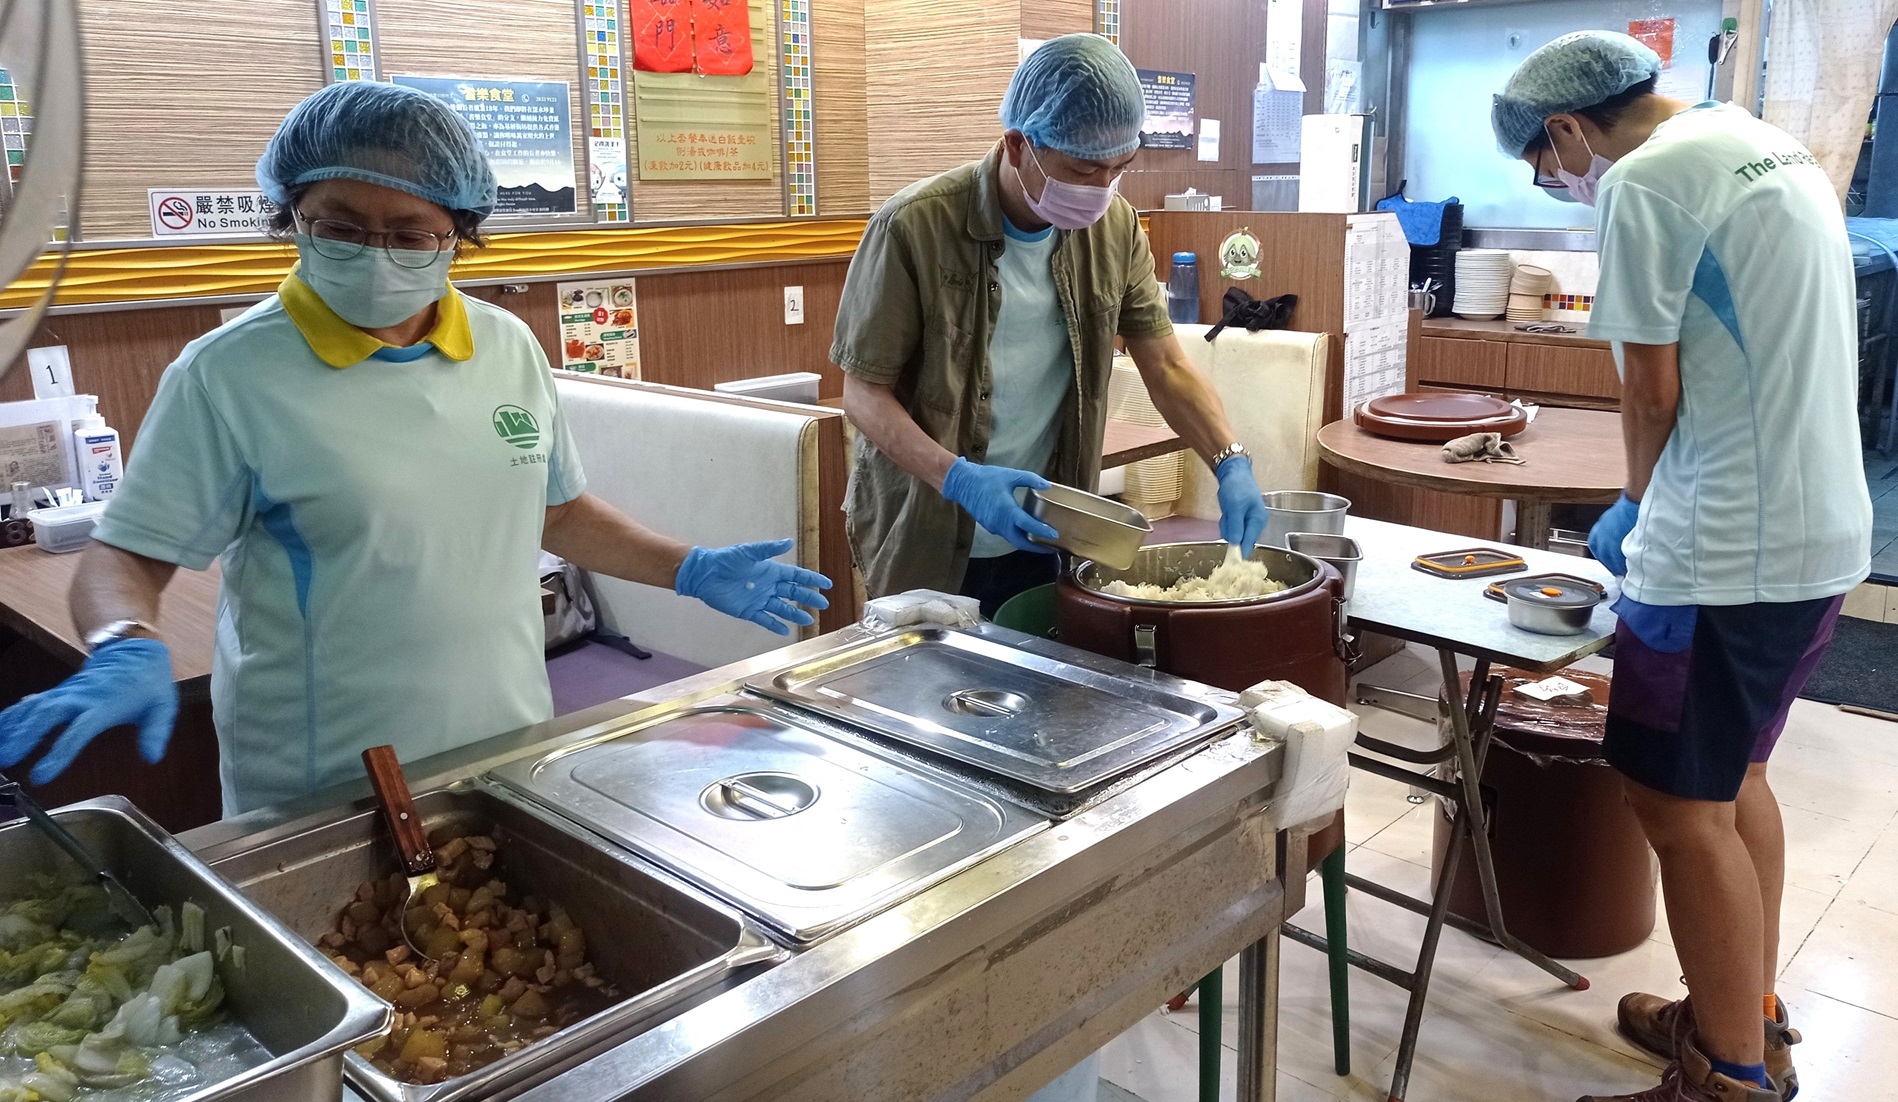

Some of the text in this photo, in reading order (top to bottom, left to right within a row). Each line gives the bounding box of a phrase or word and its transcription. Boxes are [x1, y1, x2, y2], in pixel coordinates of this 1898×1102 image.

[1734, 157, 1777, 183] The
[195, 195, 273, 214] 嚴禁吸煙
[197, 217, 270, 229] No Smokin
[790, 299, 800, 312] 2
[46, 365, 58, 385] 1
